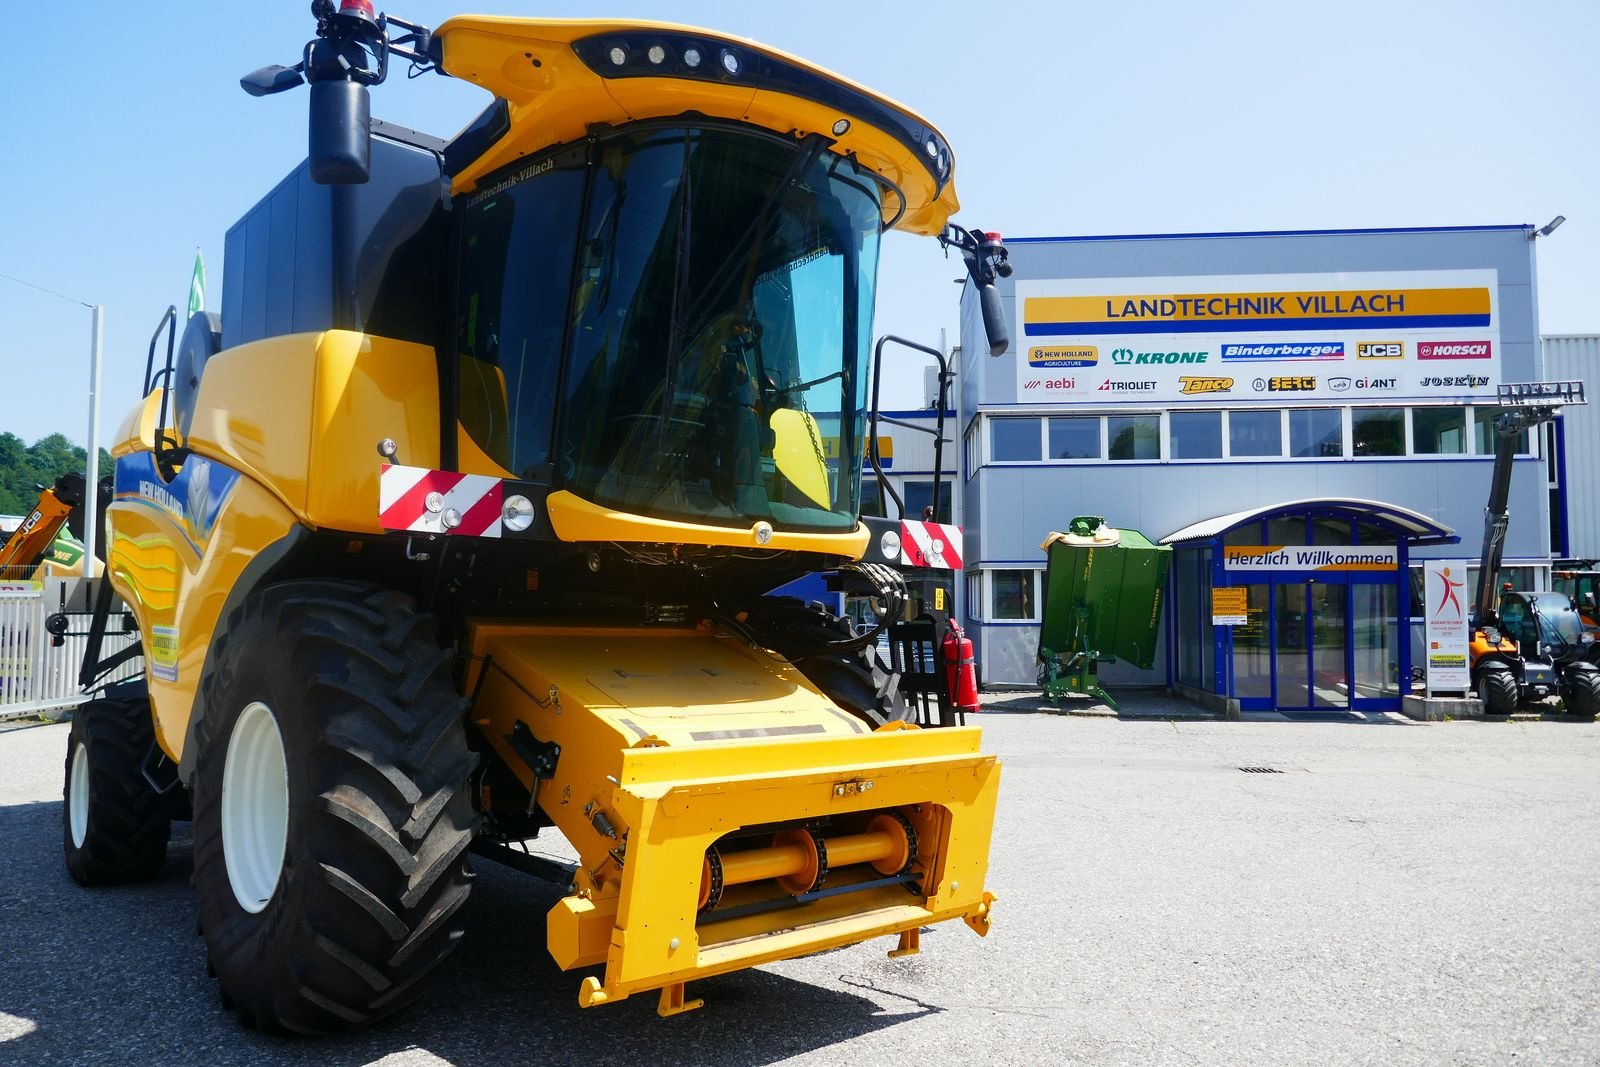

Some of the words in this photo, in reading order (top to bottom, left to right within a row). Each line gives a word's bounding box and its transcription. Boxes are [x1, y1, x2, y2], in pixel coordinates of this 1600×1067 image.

[466, 158, 553, 209] Landtechnik-Villach
[1106, 296, 1286, 318] LANDTECHNIK
[1296, 294, 1405, 314] VILLACH
[1224, 345, 1341, 357] Binderberger
[1360, 344, 1402, 357] JCB
[1433, 345, 1488, 356] HORSCH
[1135, 352, 1208, 364] KRONE
[1045, 378, 1075, 389] aebi
[1110, 381, 1157, 390] TRIOLIET
[1179, 376, 1234, 394] Tanco
[139, 480, 154, 499] NEW
[154, 484, 183, 520] HOLLAND
[22, 511, 42, 535] JCB
[1228, 551, 1289, 565] Herzlich
[1296, 550, 1394, 565] Willkommen
